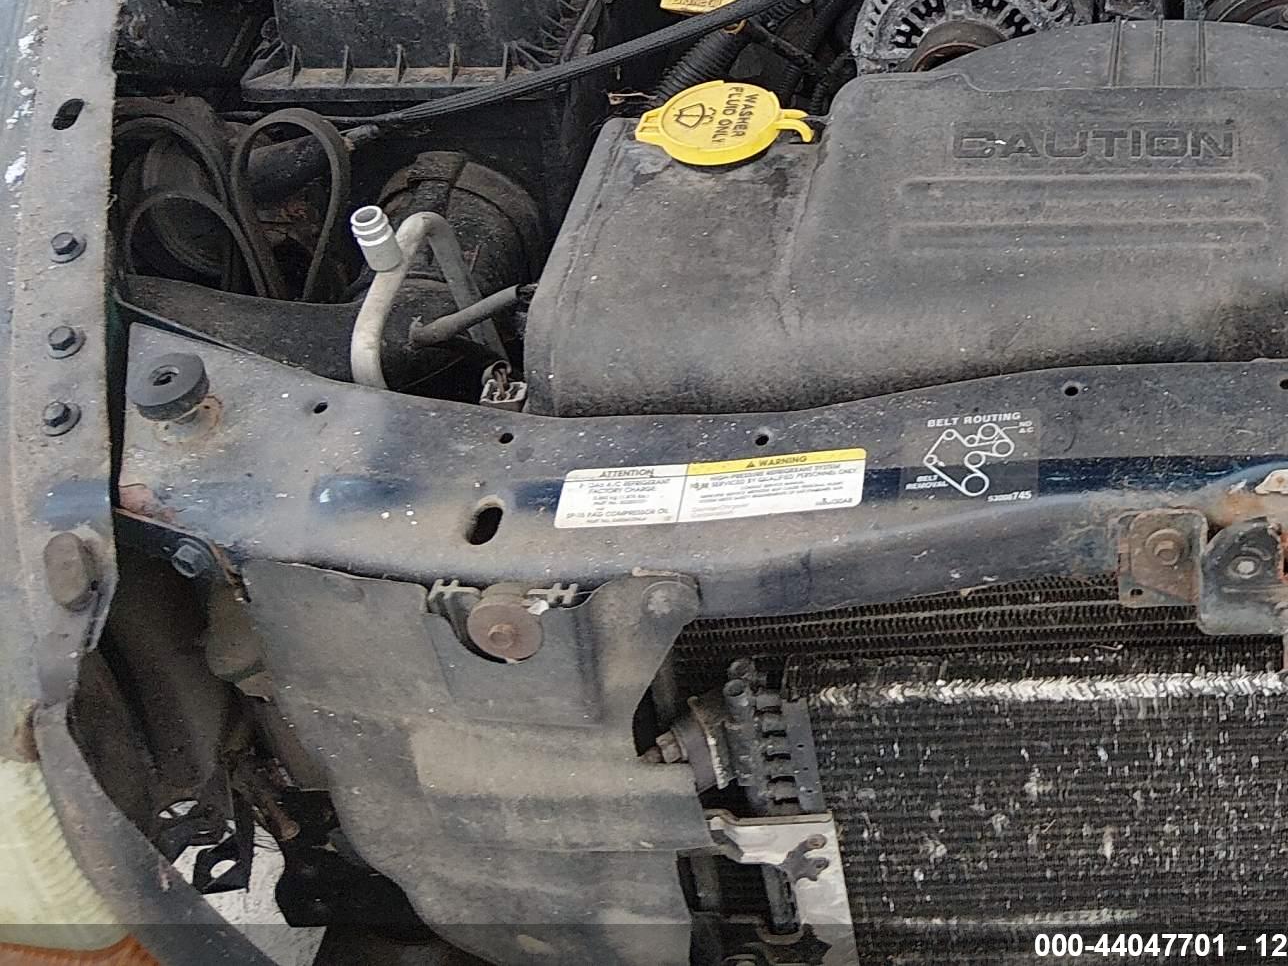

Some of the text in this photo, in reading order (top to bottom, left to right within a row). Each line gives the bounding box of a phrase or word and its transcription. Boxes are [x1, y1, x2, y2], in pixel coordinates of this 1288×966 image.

[711, 86, 744, 143] FLUID ONLY
[731, 93, 760, 138] WASHER
[952, 128, 1234, 158] CAUTION
[927, 412, 1021, 427] BELT ROUTING
[758, 455, 808, 467] WARNING
[600, 468, 655, 479] ATTENTION
[905, 480, 950, 490] REMOVAL
